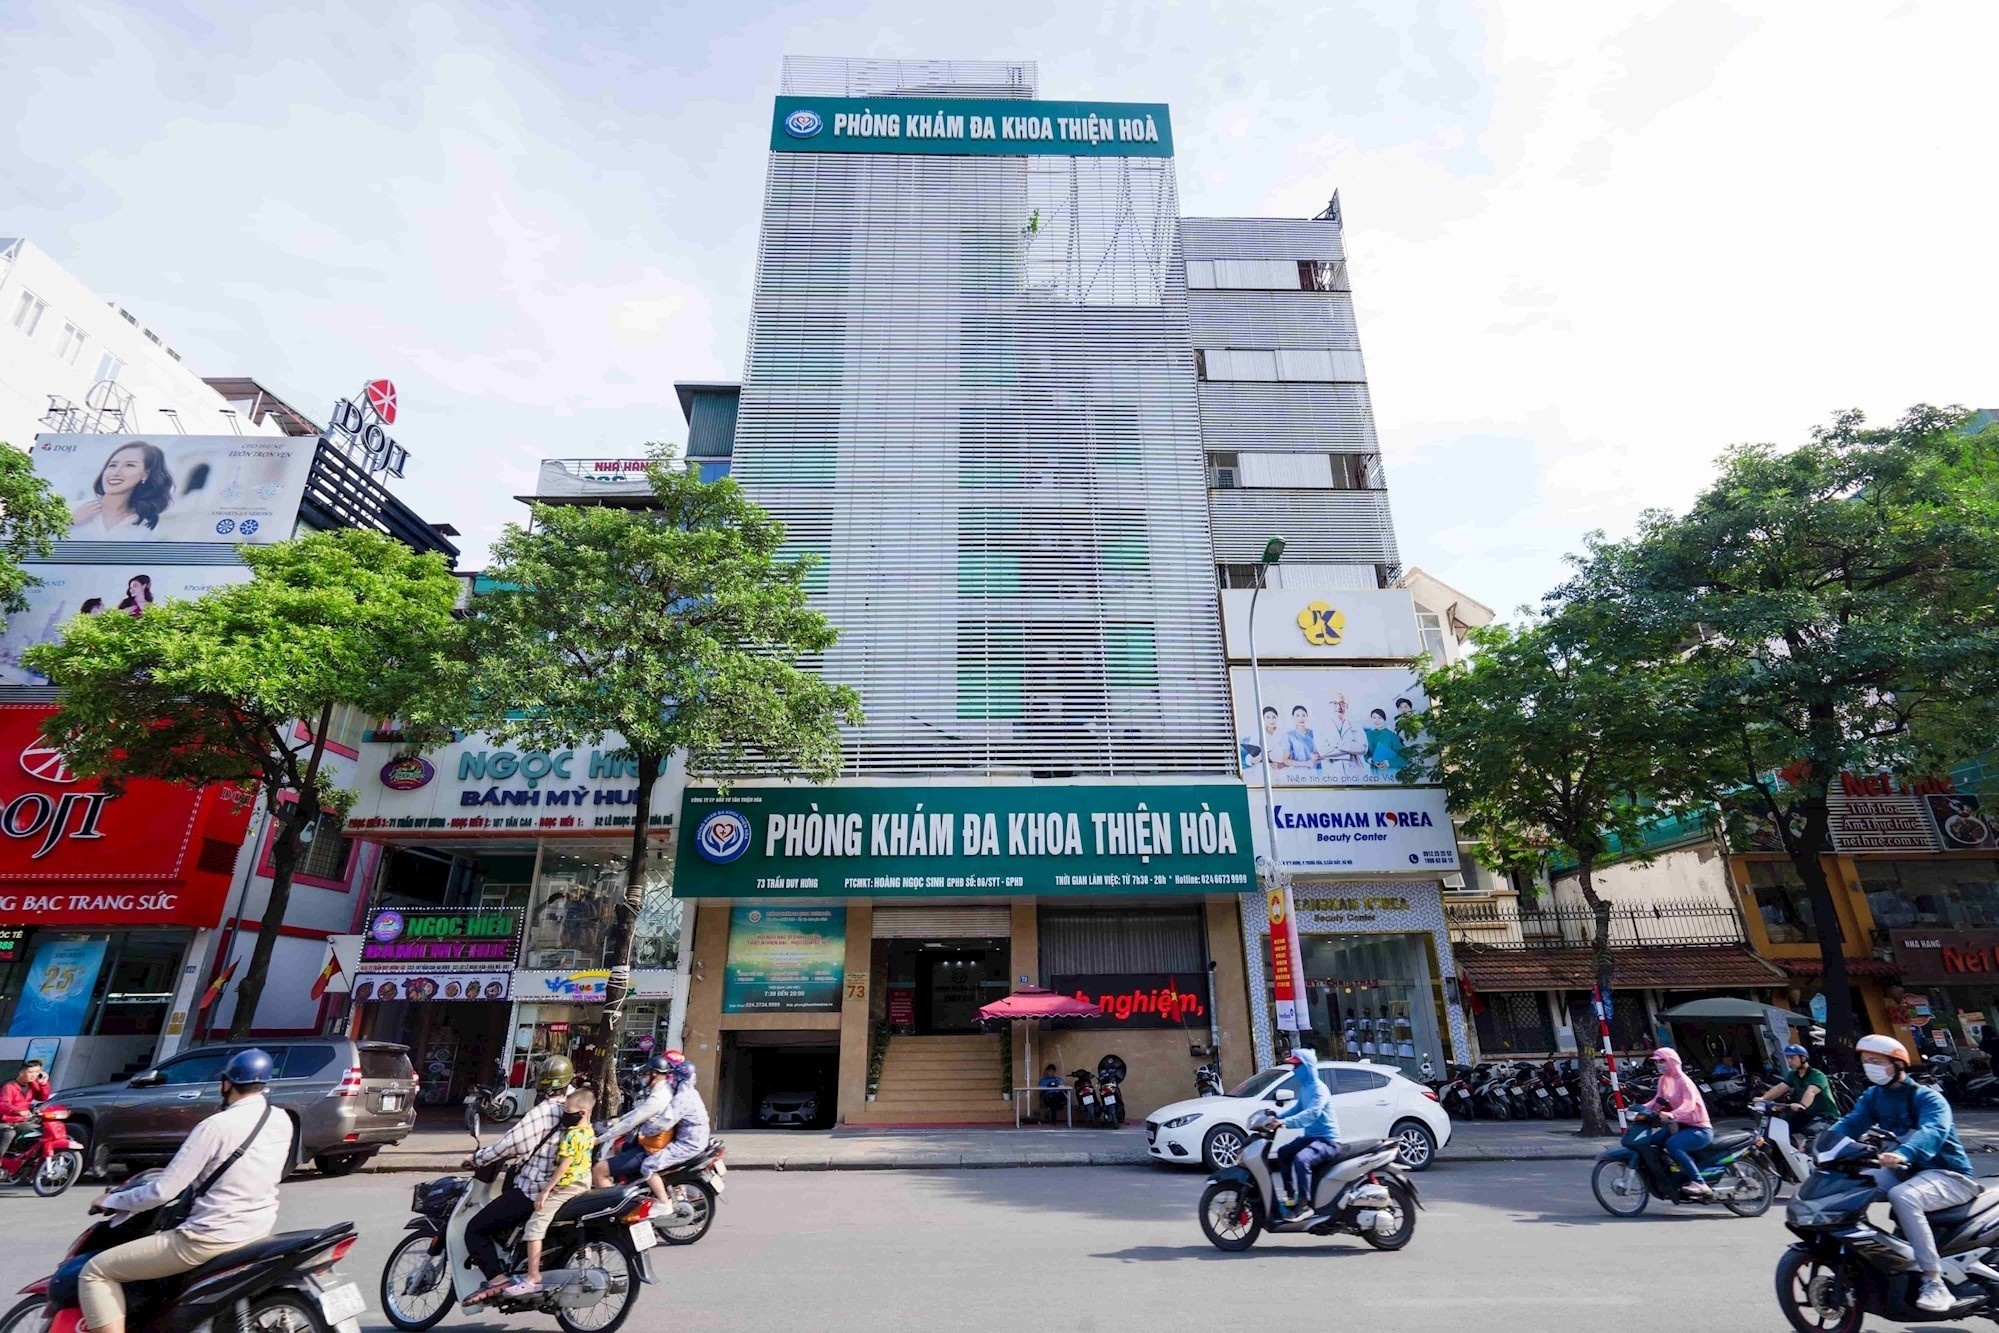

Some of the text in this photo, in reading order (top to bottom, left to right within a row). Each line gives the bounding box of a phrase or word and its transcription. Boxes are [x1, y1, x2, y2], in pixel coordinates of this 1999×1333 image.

[833, 109, 900, 138] PHÒNG
[905, 110, 964, 139] KHÁM
[969, 115, 996, 140] ĐA
[1002, 116, 1054, 141] KHOA
[1057, 113, 1114, 147] THIỆN
[1119, 114, 1159, 143] HOÀ
[53, 444, 77, 452] DOJI
[328, 397, 412, 480] DOJI
[457, 750, 575, 789] NGỌC
[1310, 774, 1320, 782] tin
[1363, 774, 1380, 784] đẹp
[460, 785, 541, 807] BÁNH
[546, 784, 590, 807] MỲ
[0, 792, 109, 860] OJI
[505, 816, 518, 828] VĂN
[520, 817, 532, 828] CAO
[1266, 805, 1433, 830] KEANGNAM KOREA
[765, 802, 1238, 864] PHÒNG KHÁM ĐA KHOA THIỆN HÒA
[1317, 832, 1388, 843] Beauty Center
[756, 875, 819, 889] 73 TRẦN DUY HƯNG
[874, 874, 901, 888] HOÀNG
[903, 876, 924, 890] NGỌC
[926, 876, 944, 888] SINH
[1056, 873, 1071, 886] THỜI
[1072, 875, 1088, 885] GIAN
[1089, 872, 1103, 886] LÀM
[1104, 872, 1121, 888] VIỆC:
[1132, 874, 1148, 885] 7h30
[1154, 874, 1166, 885] 20h
[1175, 874, 1200, 884] Hotline:
[22, 896, 64, 915] BẠC
[68, 895, 134, 911] TRANG
[136, 890, 178, 911] SỨC
[406, 916, 464, 942] NGỌC
[1314, 914, 1344, 923] Beauty
[1940, 940, 1991, 974] Nét
[847, 985, 866, 998] 73
[1100, 989, 1204, 1020] nghiệm,
